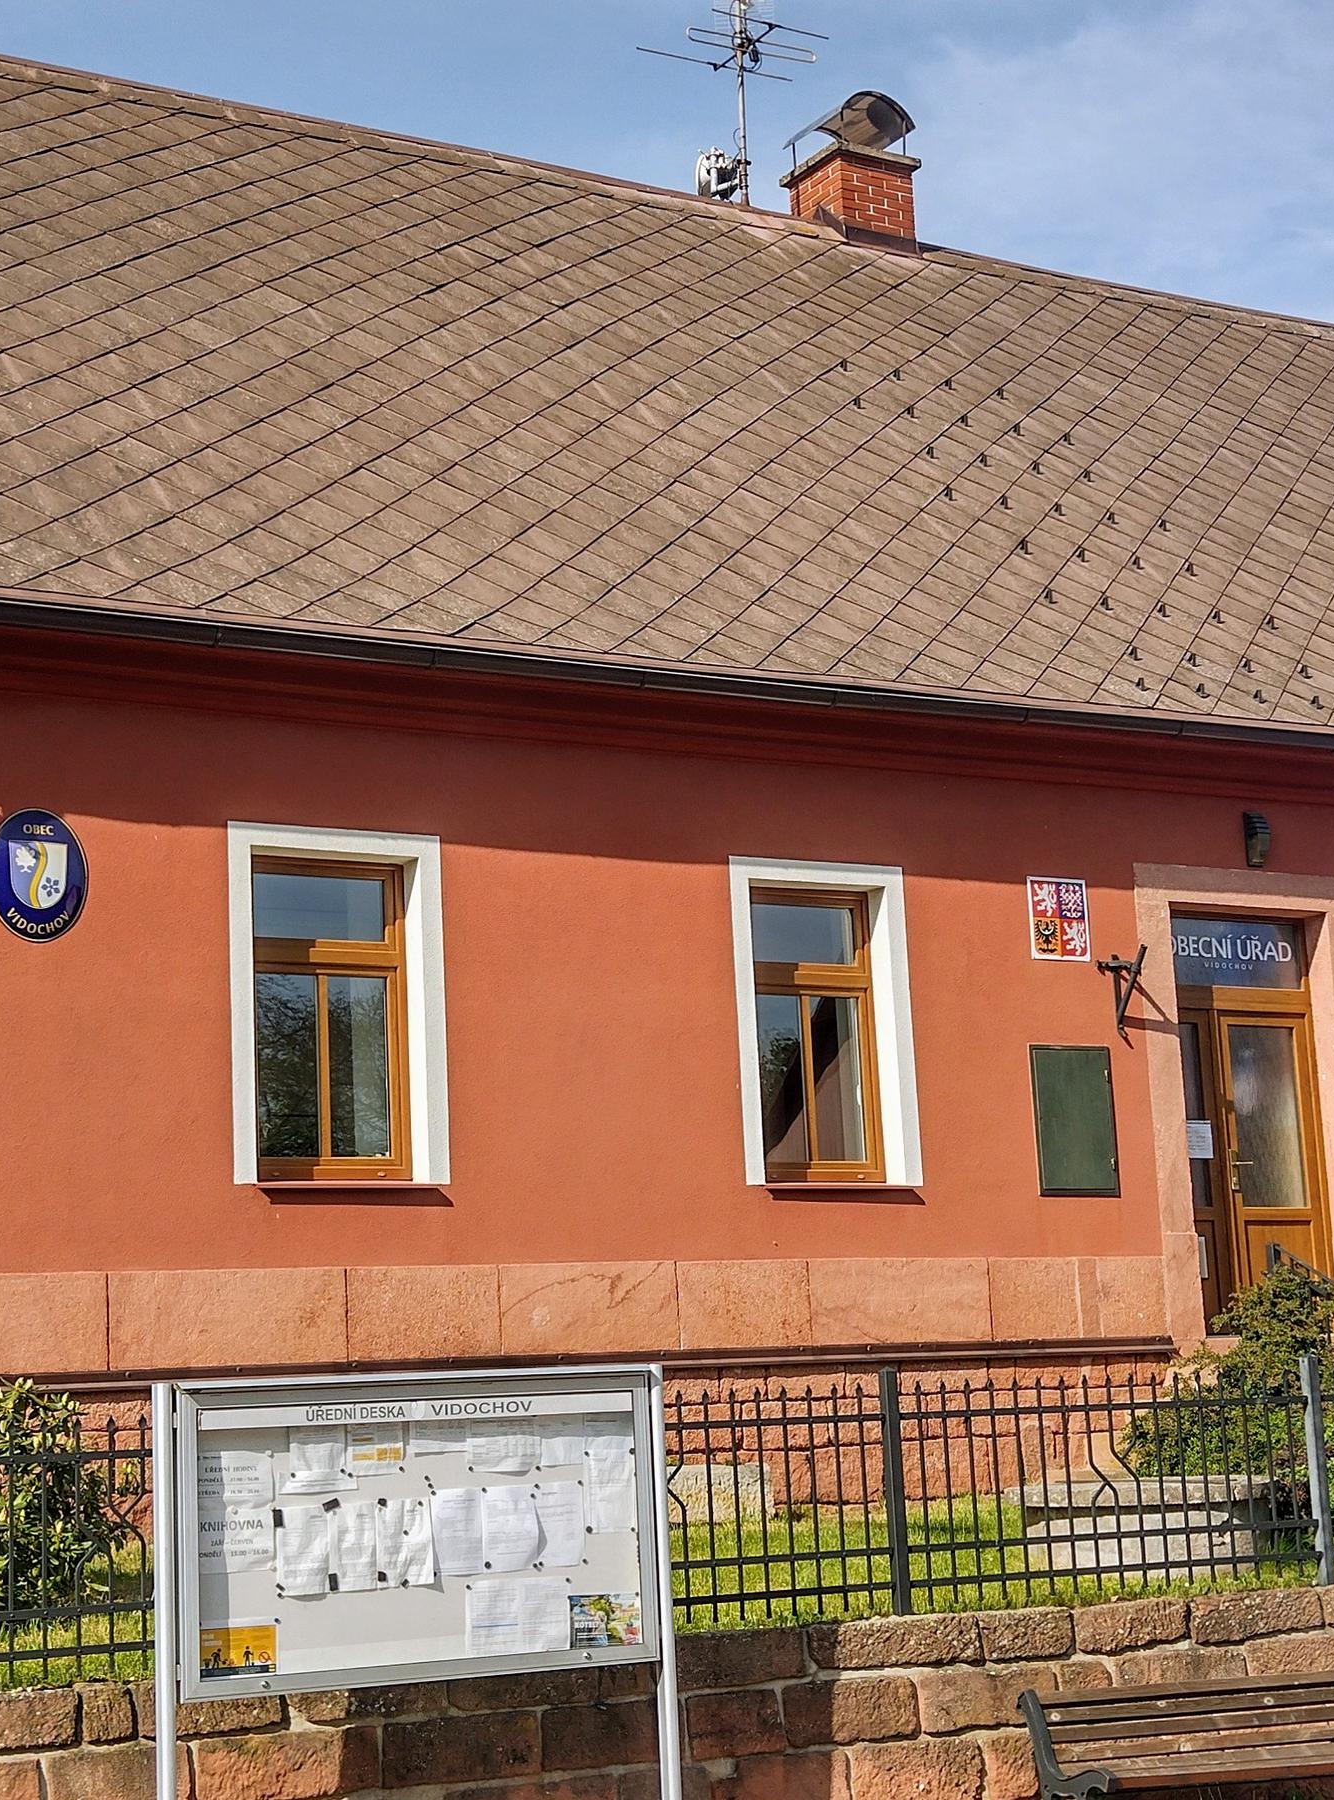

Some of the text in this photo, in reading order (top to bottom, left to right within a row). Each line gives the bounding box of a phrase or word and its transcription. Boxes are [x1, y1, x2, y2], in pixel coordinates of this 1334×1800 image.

[23, 824, 55, 836] OBEC
[7, 907, 70, 935] VIDOCHOV
[1236, 934, 1292, 962] ÚŘAD
[1204, 961, 1254, 970] VIDOCHOV
[306, 1400, 533, 1422] ÚŘEDNÍ DESKA VIDOCHOV
[200, 1519, 264, 1533] KNIHOVNA
[198, 1550, 222, 1559] ONDĚLÍ
